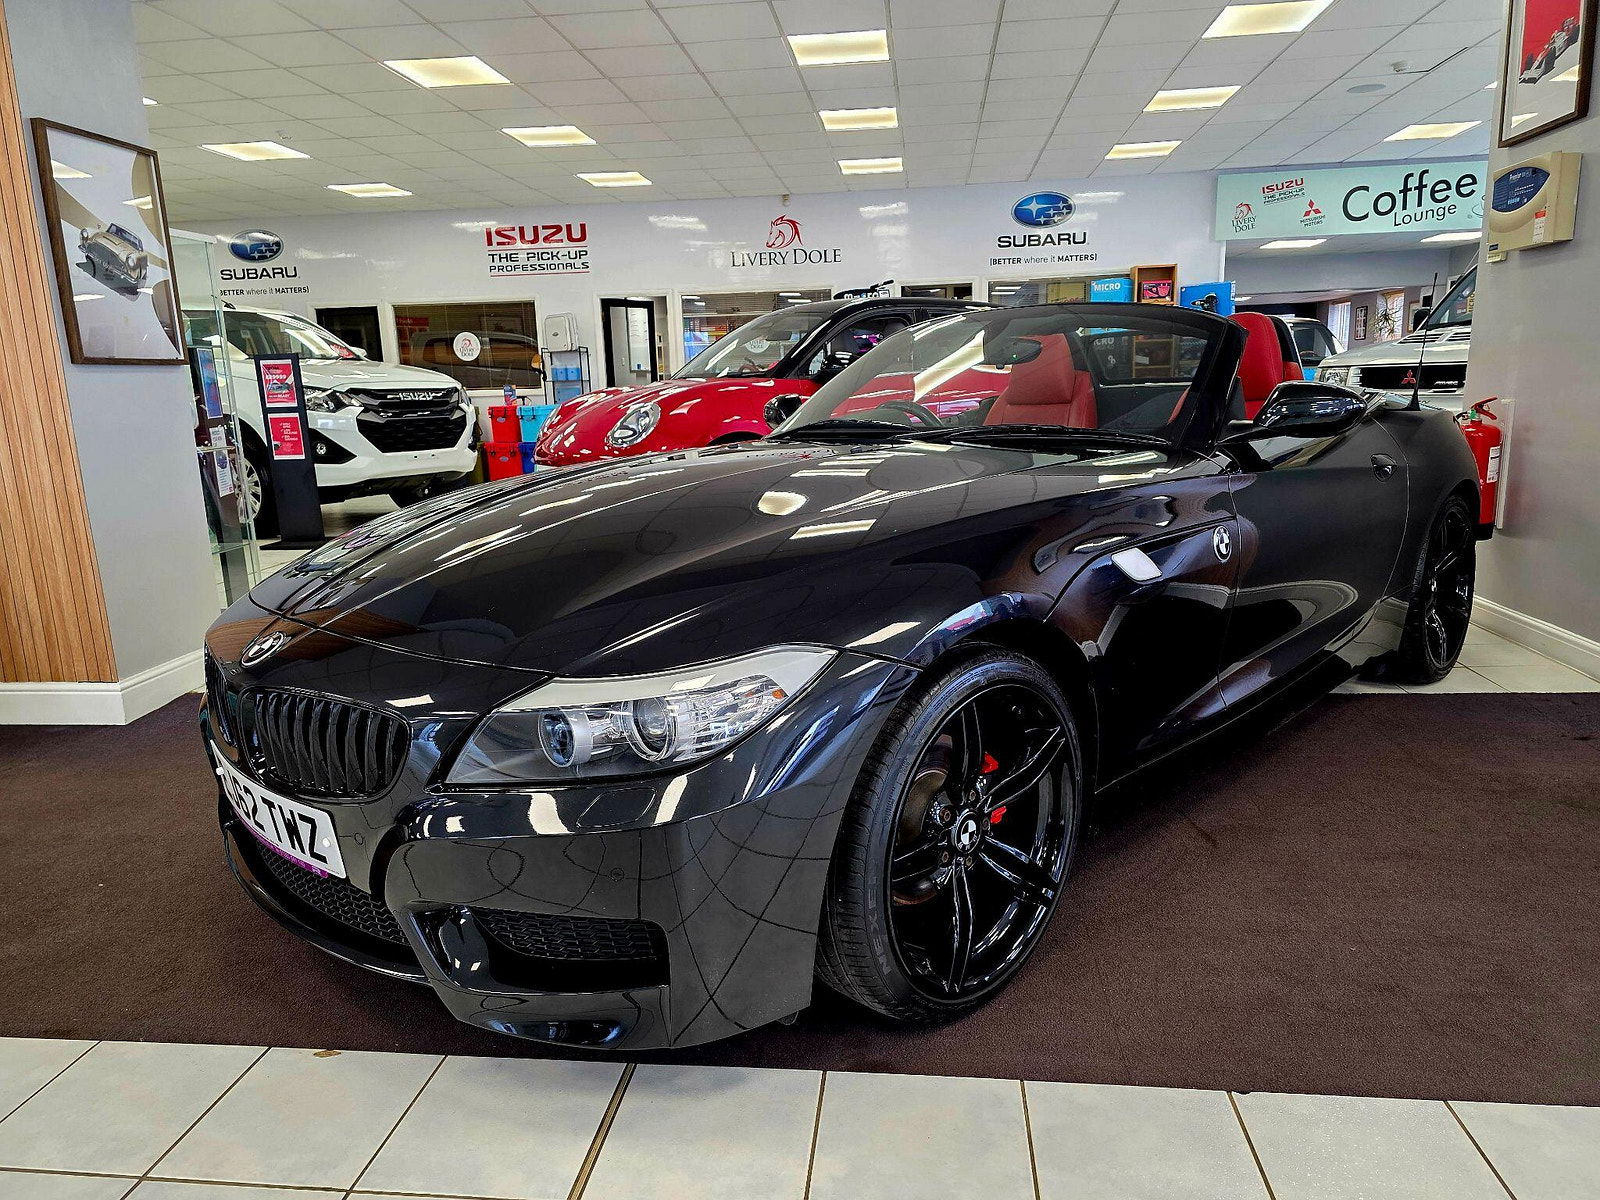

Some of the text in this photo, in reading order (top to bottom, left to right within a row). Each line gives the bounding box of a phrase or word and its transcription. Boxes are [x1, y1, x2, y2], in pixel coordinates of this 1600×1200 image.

[1262, 178, 1304, 194] ISUZU
[1342, 169, 1477, 222] Coffee
[1231, 215, 1257, 227] LIVERY
[1394, 204, 1457, 227] Lounge
[485, 222, 587, 247] ISUZU
[1234, 222, 1256, 233] DOLE
[997, 231, 1087, 248] SUBARU
[488, 249, 588, 263] THE PICK-UP
[731, 248, 842, 267] LIVERY DOLE
[1023, 255, 1049, 264] where
[1050, 255, 1056, 263] it
[220, 266, 298, 280] SUBARU
[489, 261, 590, 273] PROFESSIONALS
[246, 287, 267, 295] where
[1094, 282, 1121, 292] MICRO
[399, 392, 433, 401] ISUZU
[260, 795, 328, 865] TWZ
